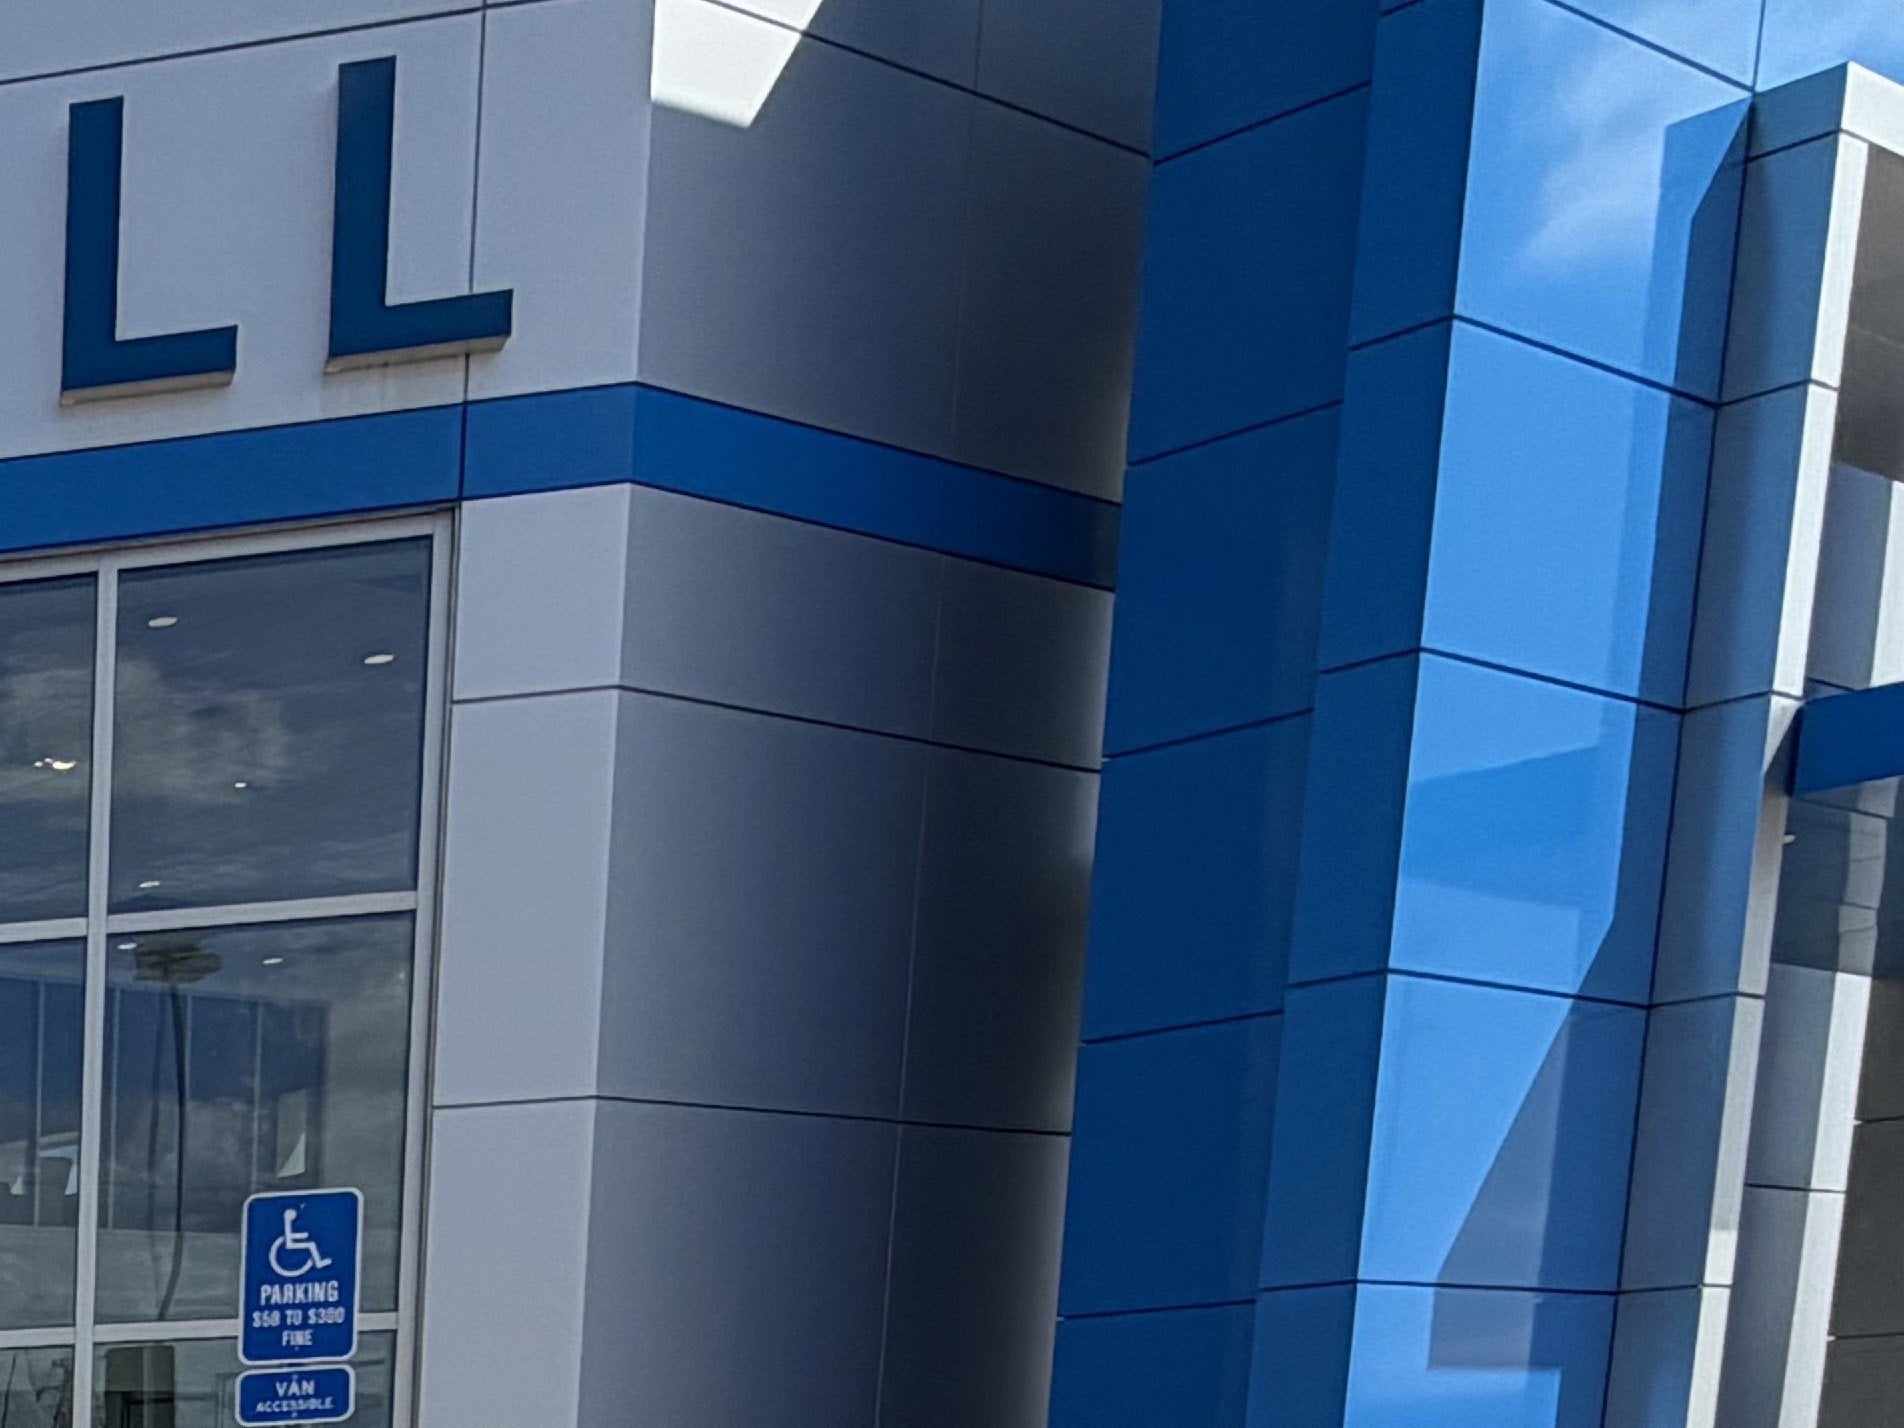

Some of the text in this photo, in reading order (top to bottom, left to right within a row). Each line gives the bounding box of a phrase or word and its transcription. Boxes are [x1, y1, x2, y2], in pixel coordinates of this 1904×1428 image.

[260, 1280, 340, 1305] PARKING
[285, 1309, 302, 1325] TO
[282, 1329, 313, 1346] FINE
[275, 1380, 315, 1397] VAN
